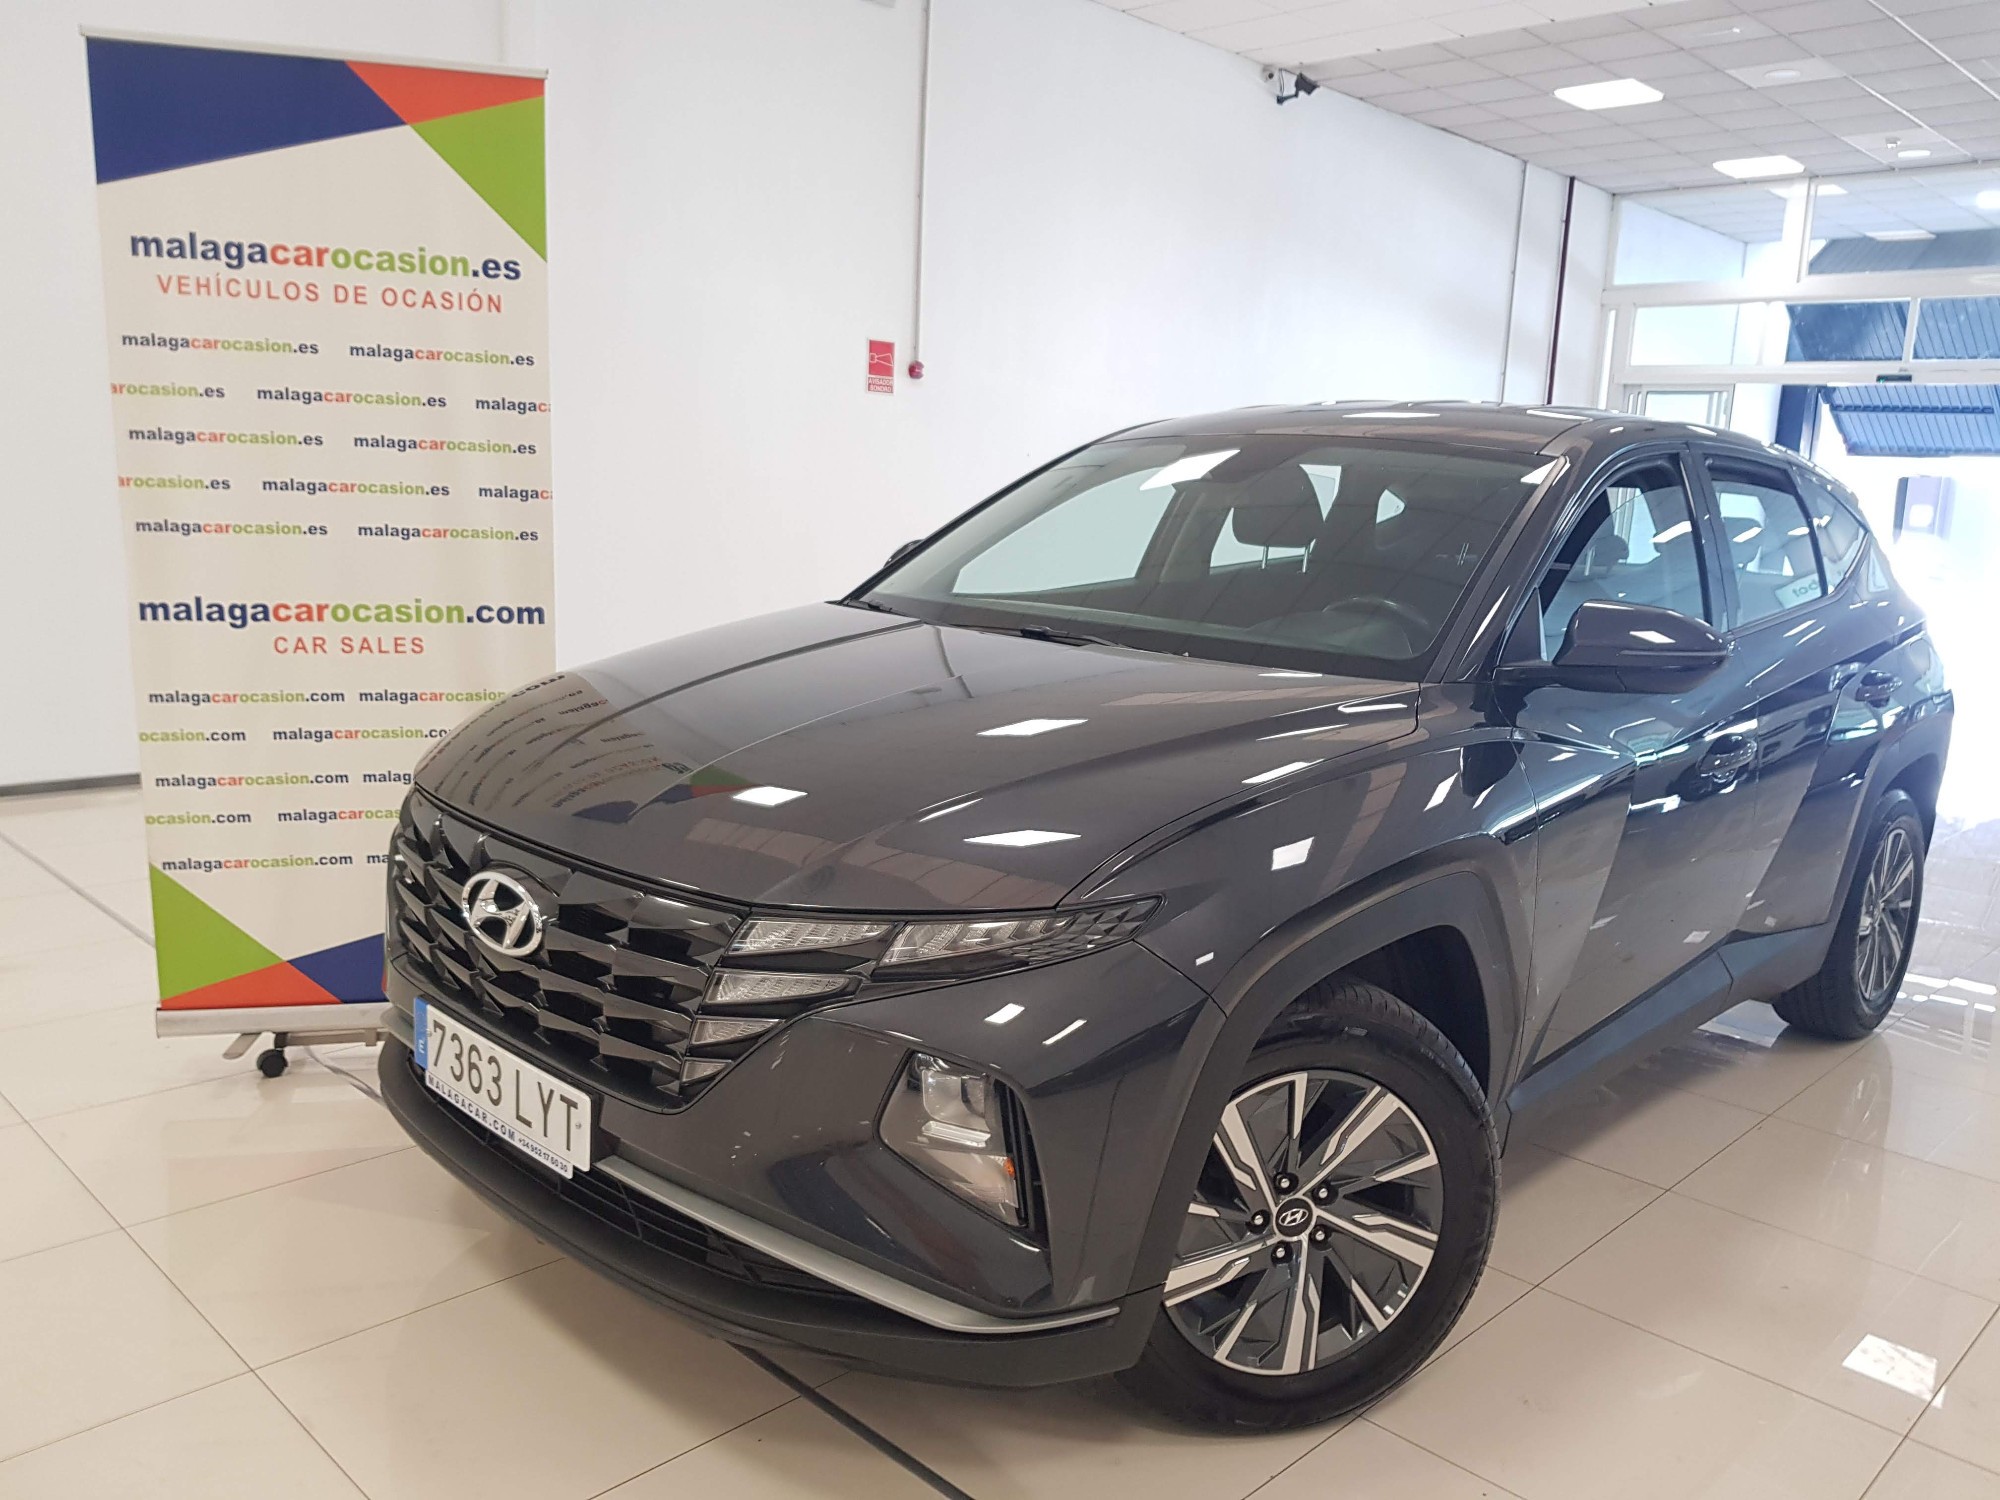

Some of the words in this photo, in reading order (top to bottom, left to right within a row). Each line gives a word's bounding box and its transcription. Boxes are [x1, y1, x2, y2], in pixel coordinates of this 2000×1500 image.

[130, 232, 521, 281] malagacarocasion.es
[157, 273, 319, 302] VEHÍCULOS
[334, 284, 367, 305] DE
[381, 287, 501, 313] OCASIÓN
[122, 333, 319, 354] malagacarocasion.es
[349, 344, 534, 366] malagacarocasion.es
[257, 387, 447, 408] malagacarocasion.es
[476, 397, 551, 415] malagac
[128, 427, 323, 446] malagacarocasion.es
[354, 435, 536, 454] malagacarocasion.es
[262, 478, 450, 496] malagacarocasion.es
[479, 485, 553, 502] malagac
[136, 519, 328, 537] malagacarocasion.es
[358, 524, 539, 541] malagacarocasion.es
[139, 596, 545, 629] malagacarocasion.com
[274, 636, 327, 654] CAR
[341, 636, 424, 654] SALES
[149, 690, 345, 706] malagacarocasion.com
[139, 729, 246, 742] ocasion.com
[273, 726, 449, 744] malagacarocasion.co
[155, 772, 349, 790] malagacarocasion.com
[363, 770, 415, 787] malag
[146, 812, 252, 825] ocasion.com
[162, 855, 353, 873] malagacarocasion.com
[433, 1019, 503, 1107] 7363
[515, 1068, 579, 1152] LYT
[428, 1074, 516, 1142] MALAGACAR.COM
